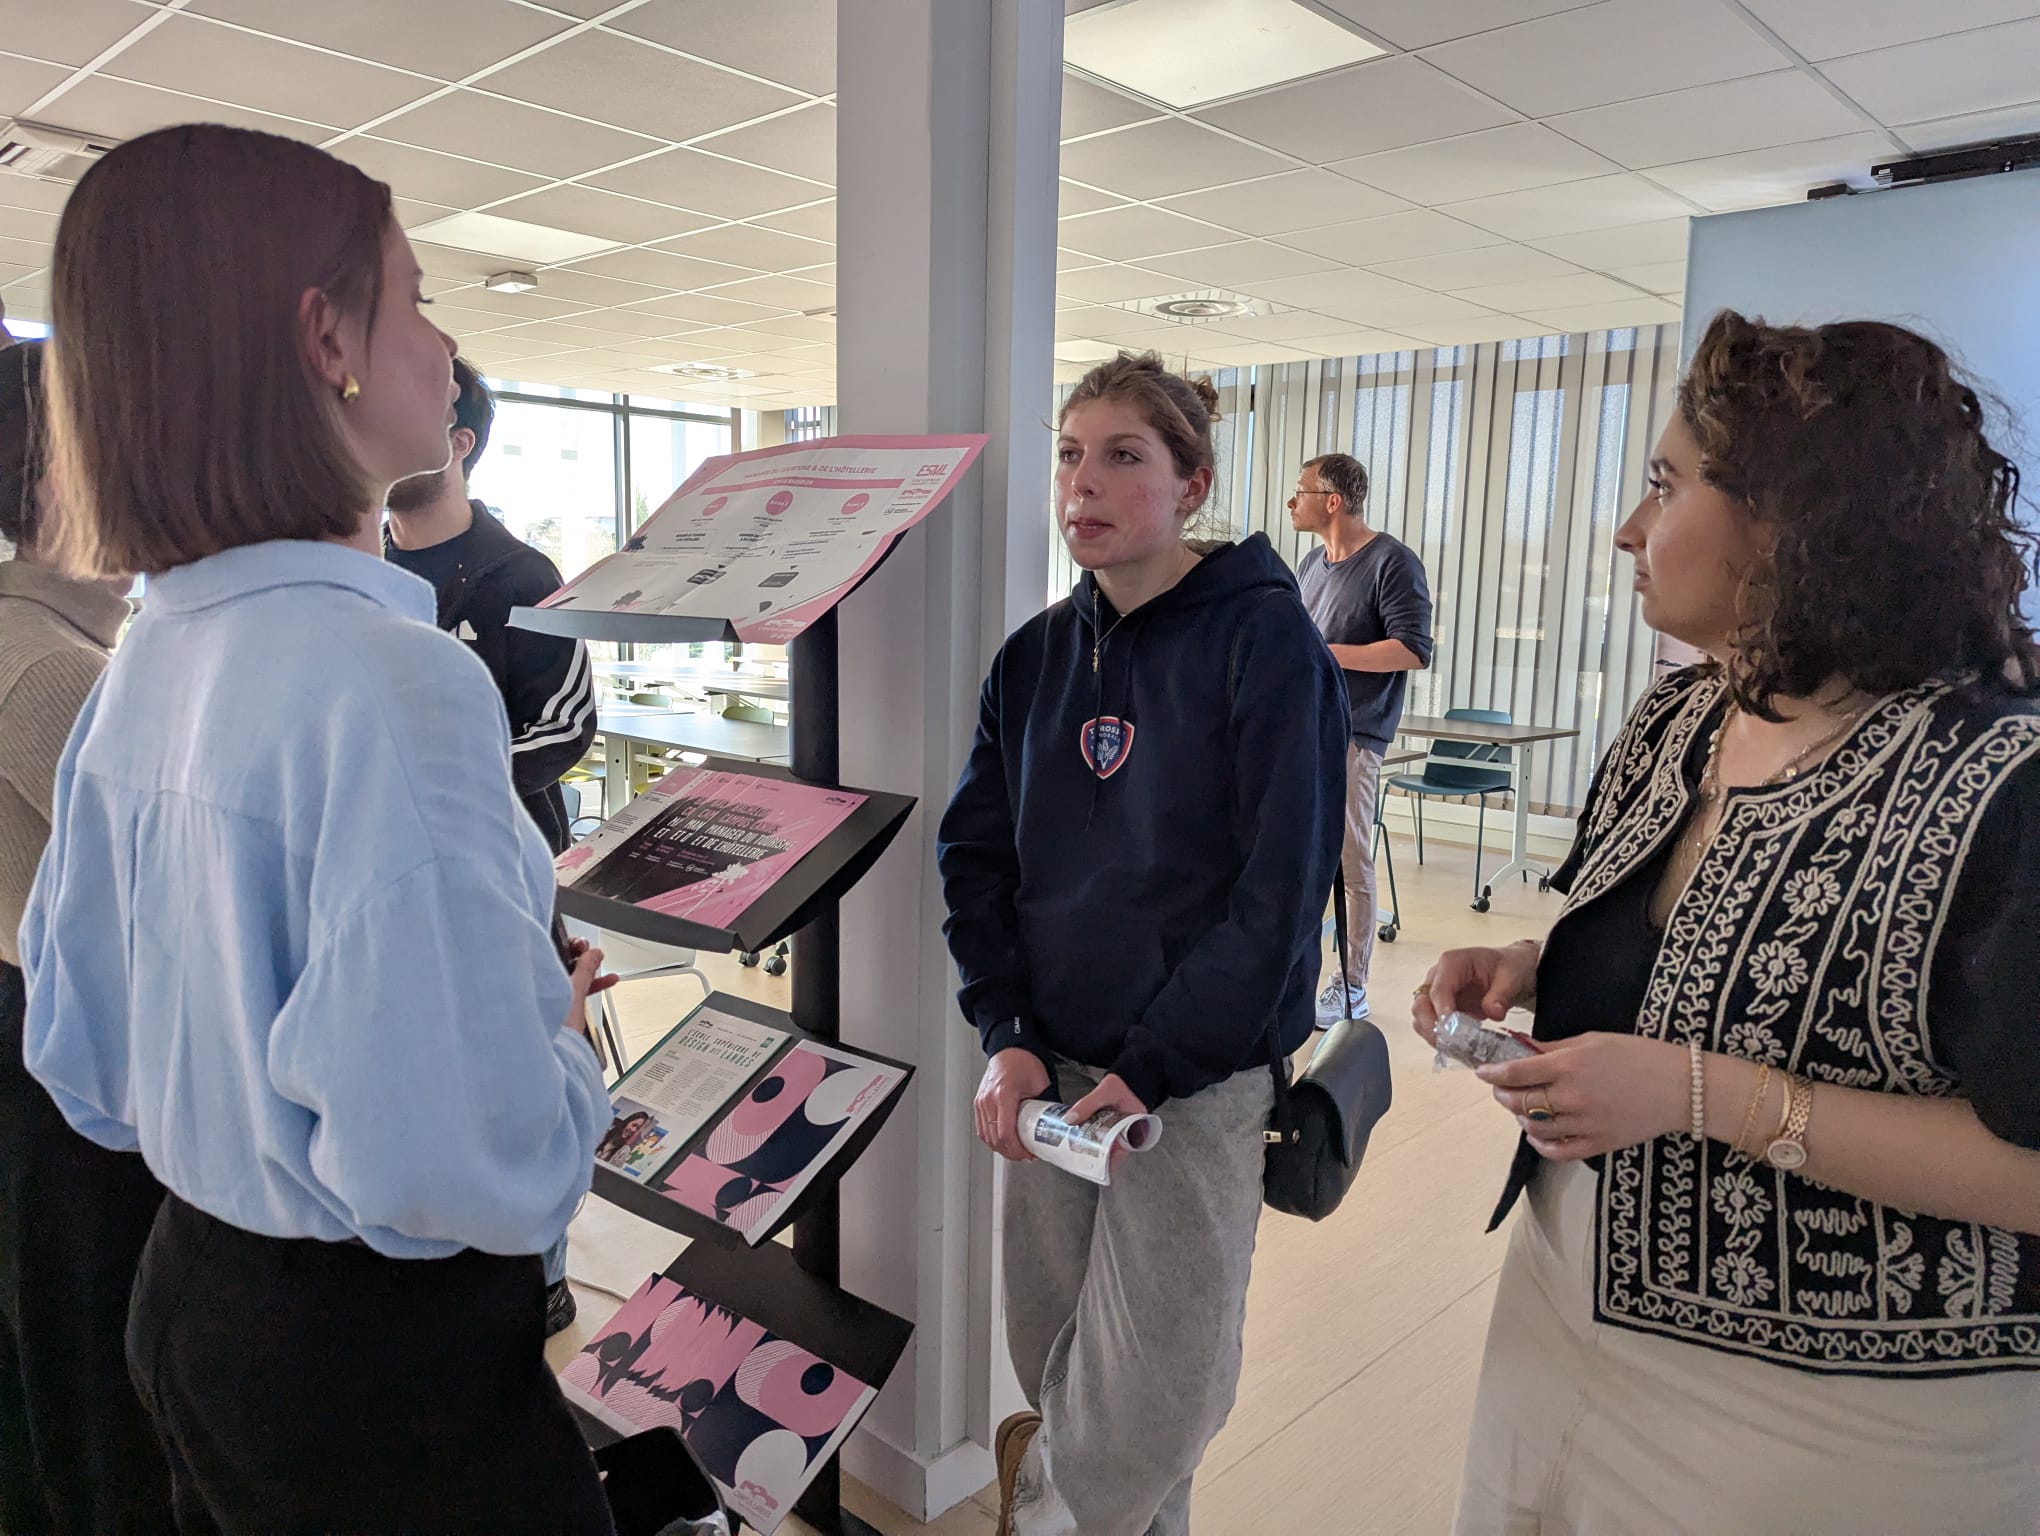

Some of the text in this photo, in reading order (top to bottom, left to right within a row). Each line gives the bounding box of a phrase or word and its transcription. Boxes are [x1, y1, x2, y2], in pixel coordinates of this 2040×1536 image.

[704, 824, 746, 840] MANAGER
[691, 835, 709, 847] ET
[678, 1035, 711, 1053] DESIGN
[719, 1049, 755, 1068] LANDES
